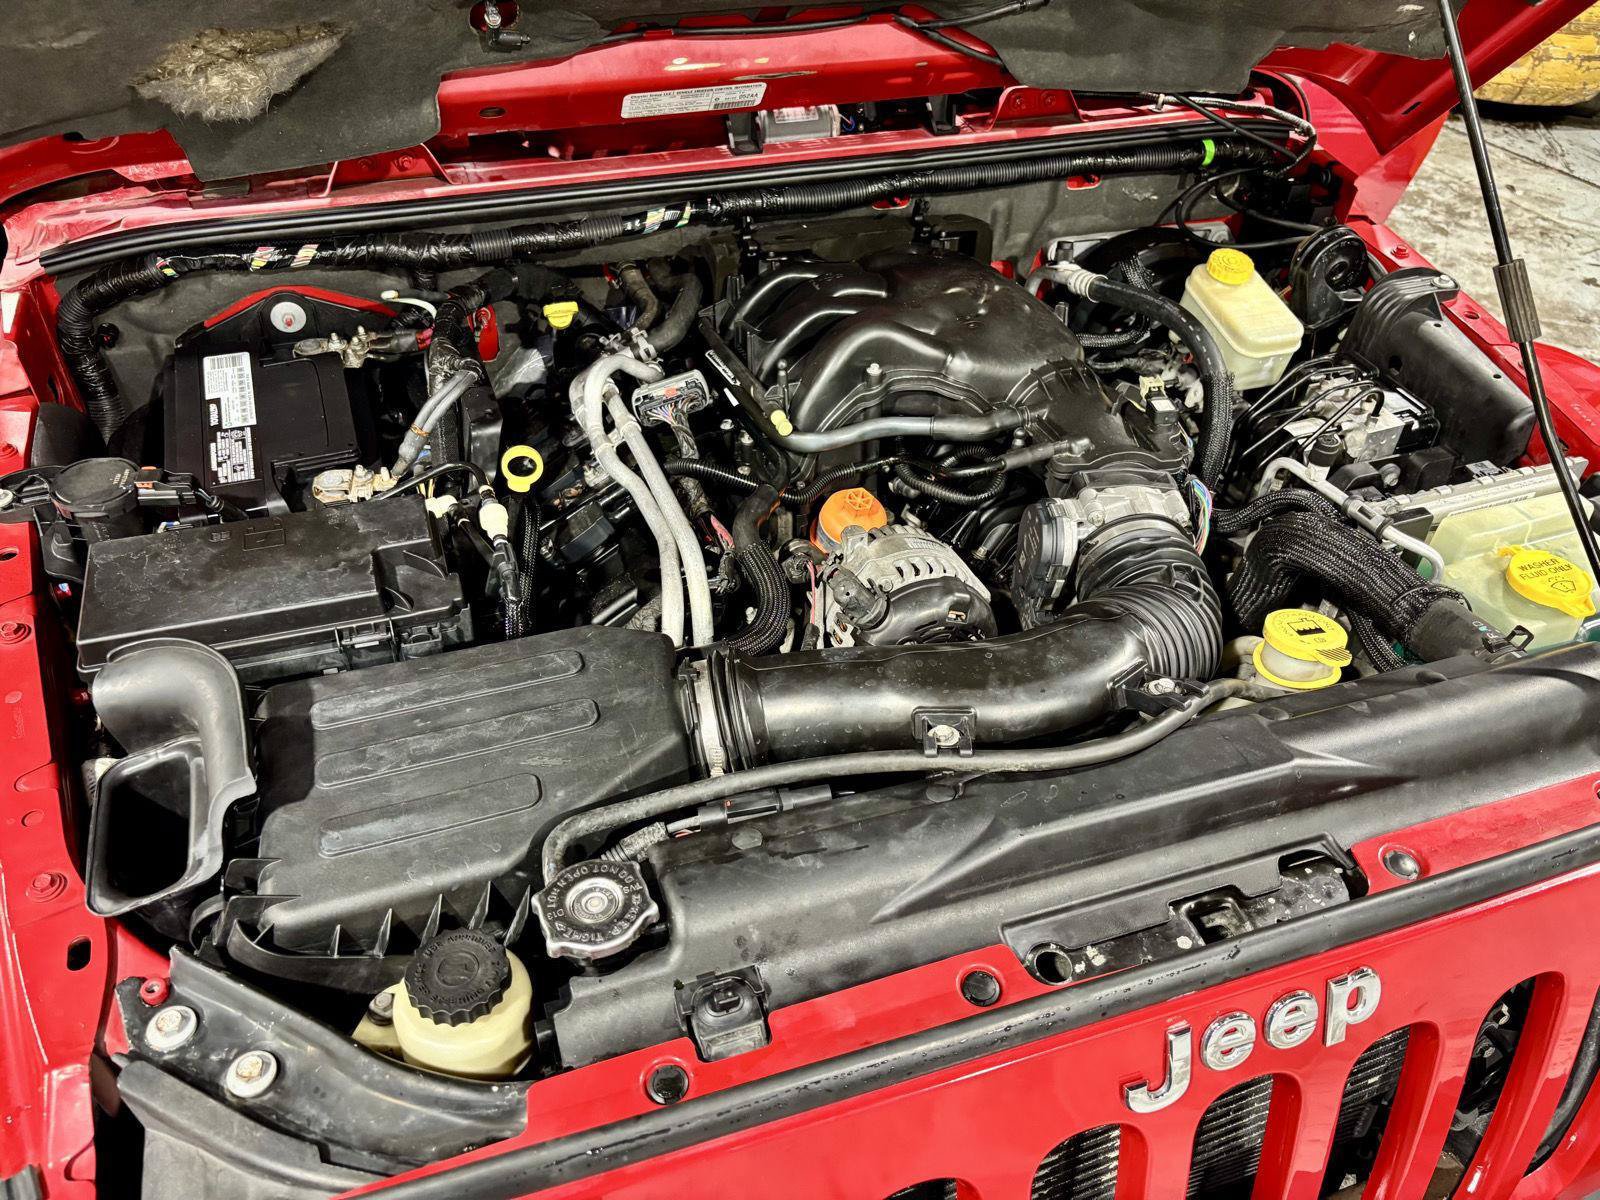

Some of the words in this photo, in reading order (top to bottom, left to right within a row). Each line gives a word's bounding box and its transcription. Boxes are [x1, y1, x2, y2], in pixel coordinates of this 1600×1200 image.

[1519, 558, 1559, 572] WASHER
[1519, 569, 1548, 580] FLUID
[1548, 563, 1573, 575] ONLY
[556, 866, 588, 887] OPEN
[592, 864, 618, 874] NOT
[1122, 966, 1383, 1114] Jeep
